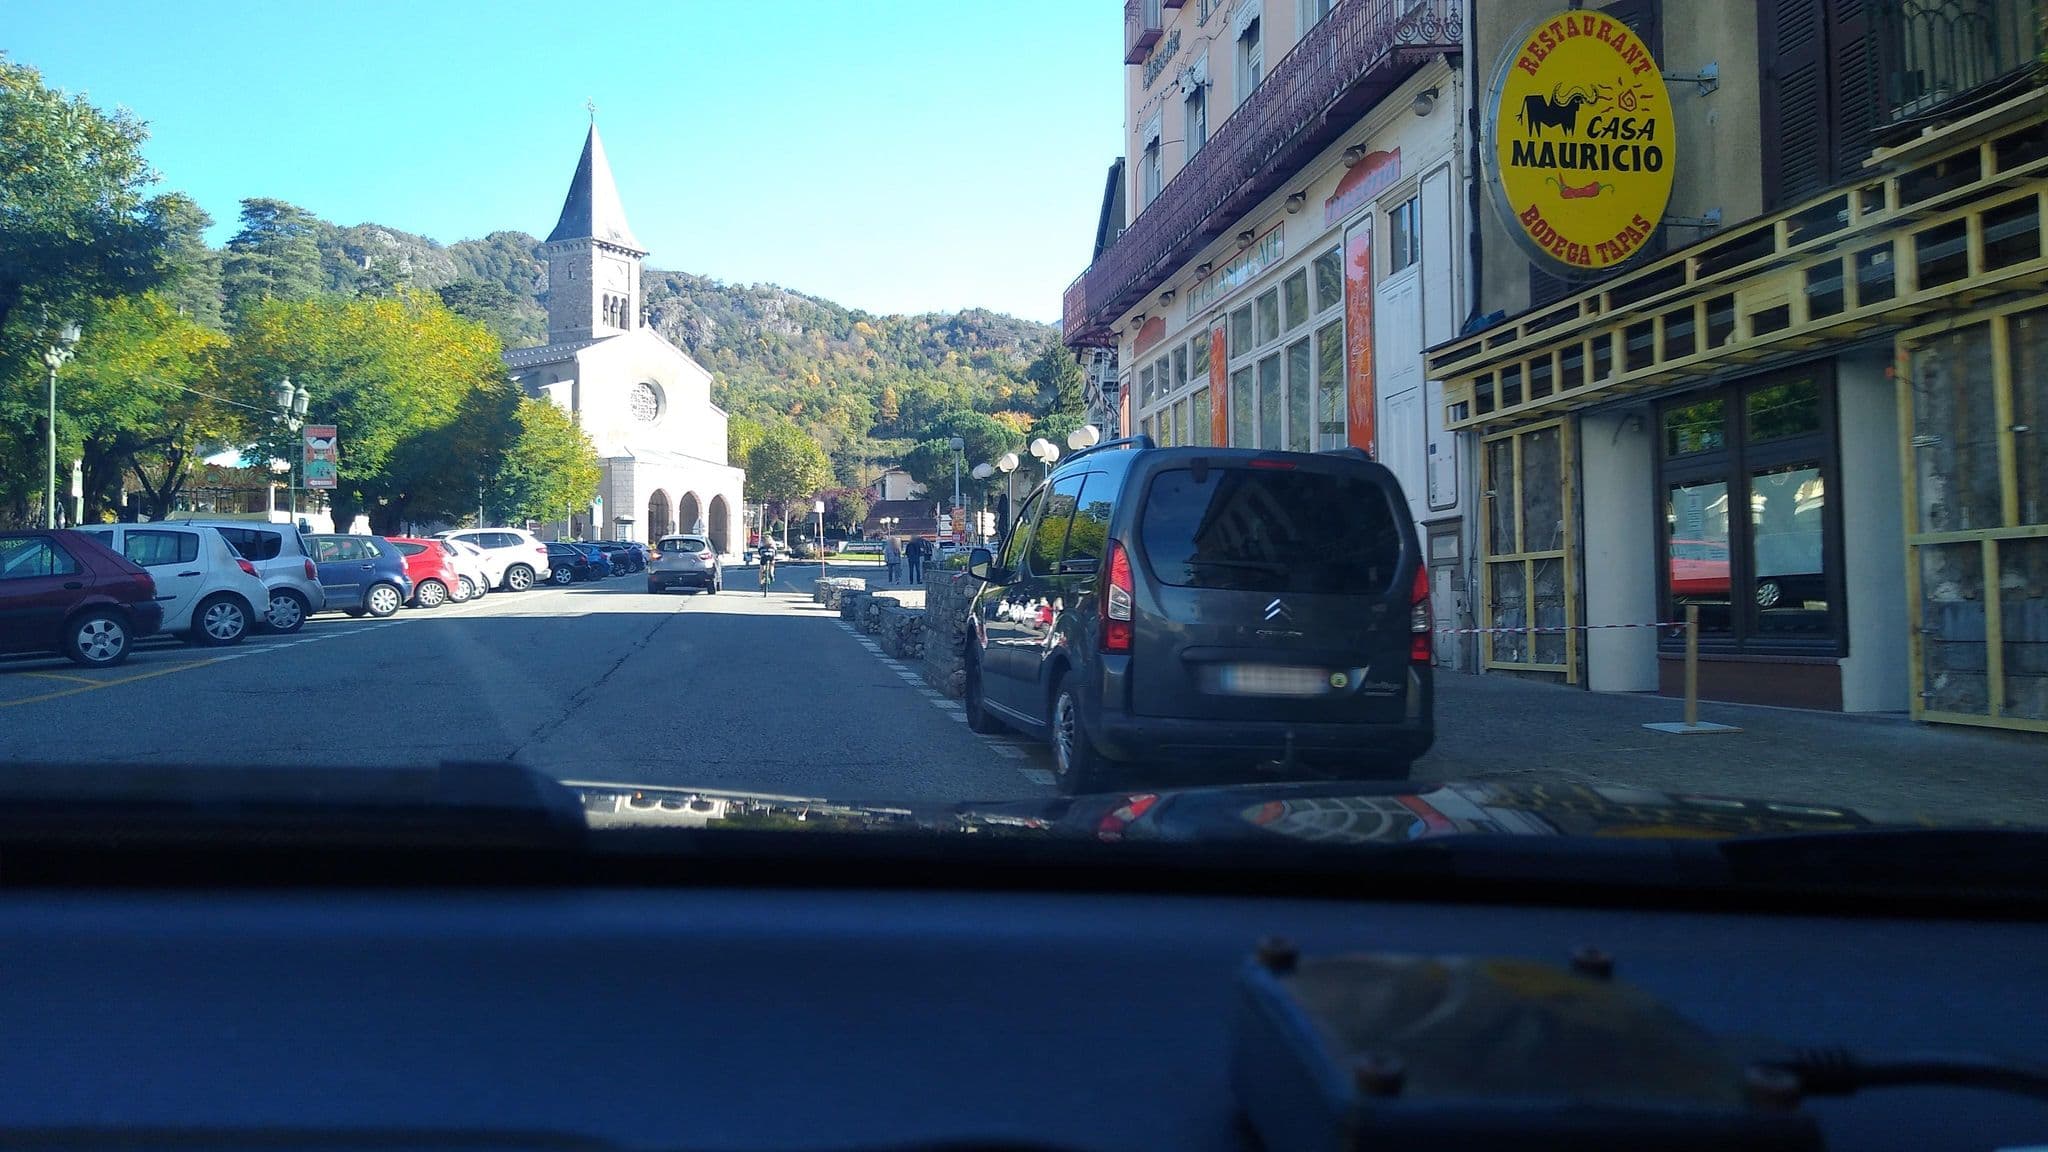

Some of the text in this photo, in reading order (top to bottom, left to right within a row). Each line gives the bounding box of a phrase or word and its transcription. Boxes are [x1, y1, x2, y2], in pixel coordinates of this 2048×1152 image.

[1518, 15, 1652, 76] RESTAURANT
[1587, 116, 1655, 141] CASA
[1511, 140, 1663, 172] MAURICIO
[1520, 203, 1652, 265] BODEGA TAPAS
